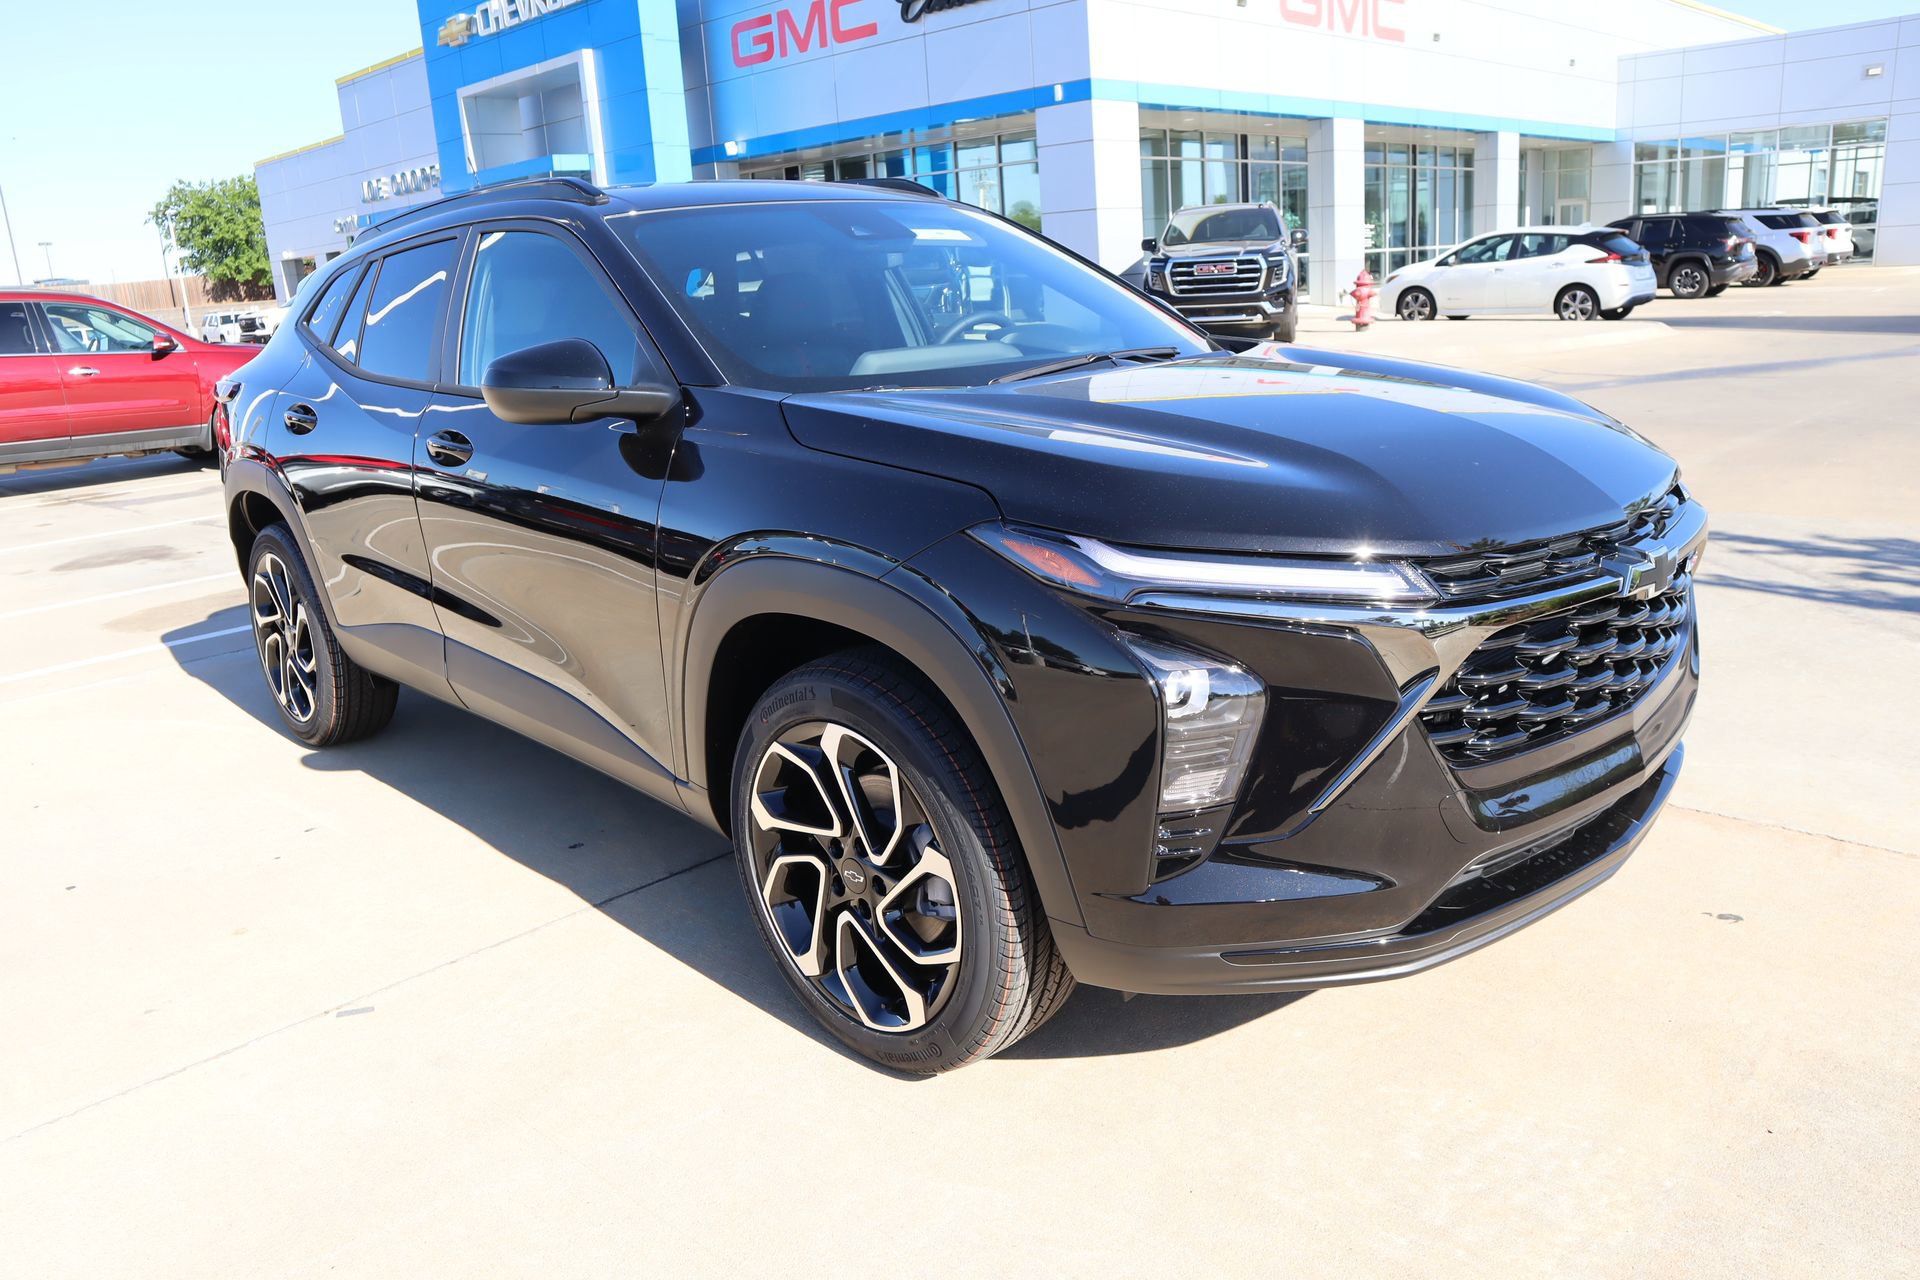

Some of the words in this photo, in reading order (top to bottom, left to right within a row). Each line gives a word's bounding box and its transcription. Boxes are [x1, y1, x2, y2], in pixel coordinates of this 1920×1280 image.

[731, 0, 878, 68] GMC
[1279, 0, 1406, 43] GMC
[390, 164, 440, 196] COOPE
[760, 686, 808, 725] Continental
[885, 1042, 943, 1064] Continental
